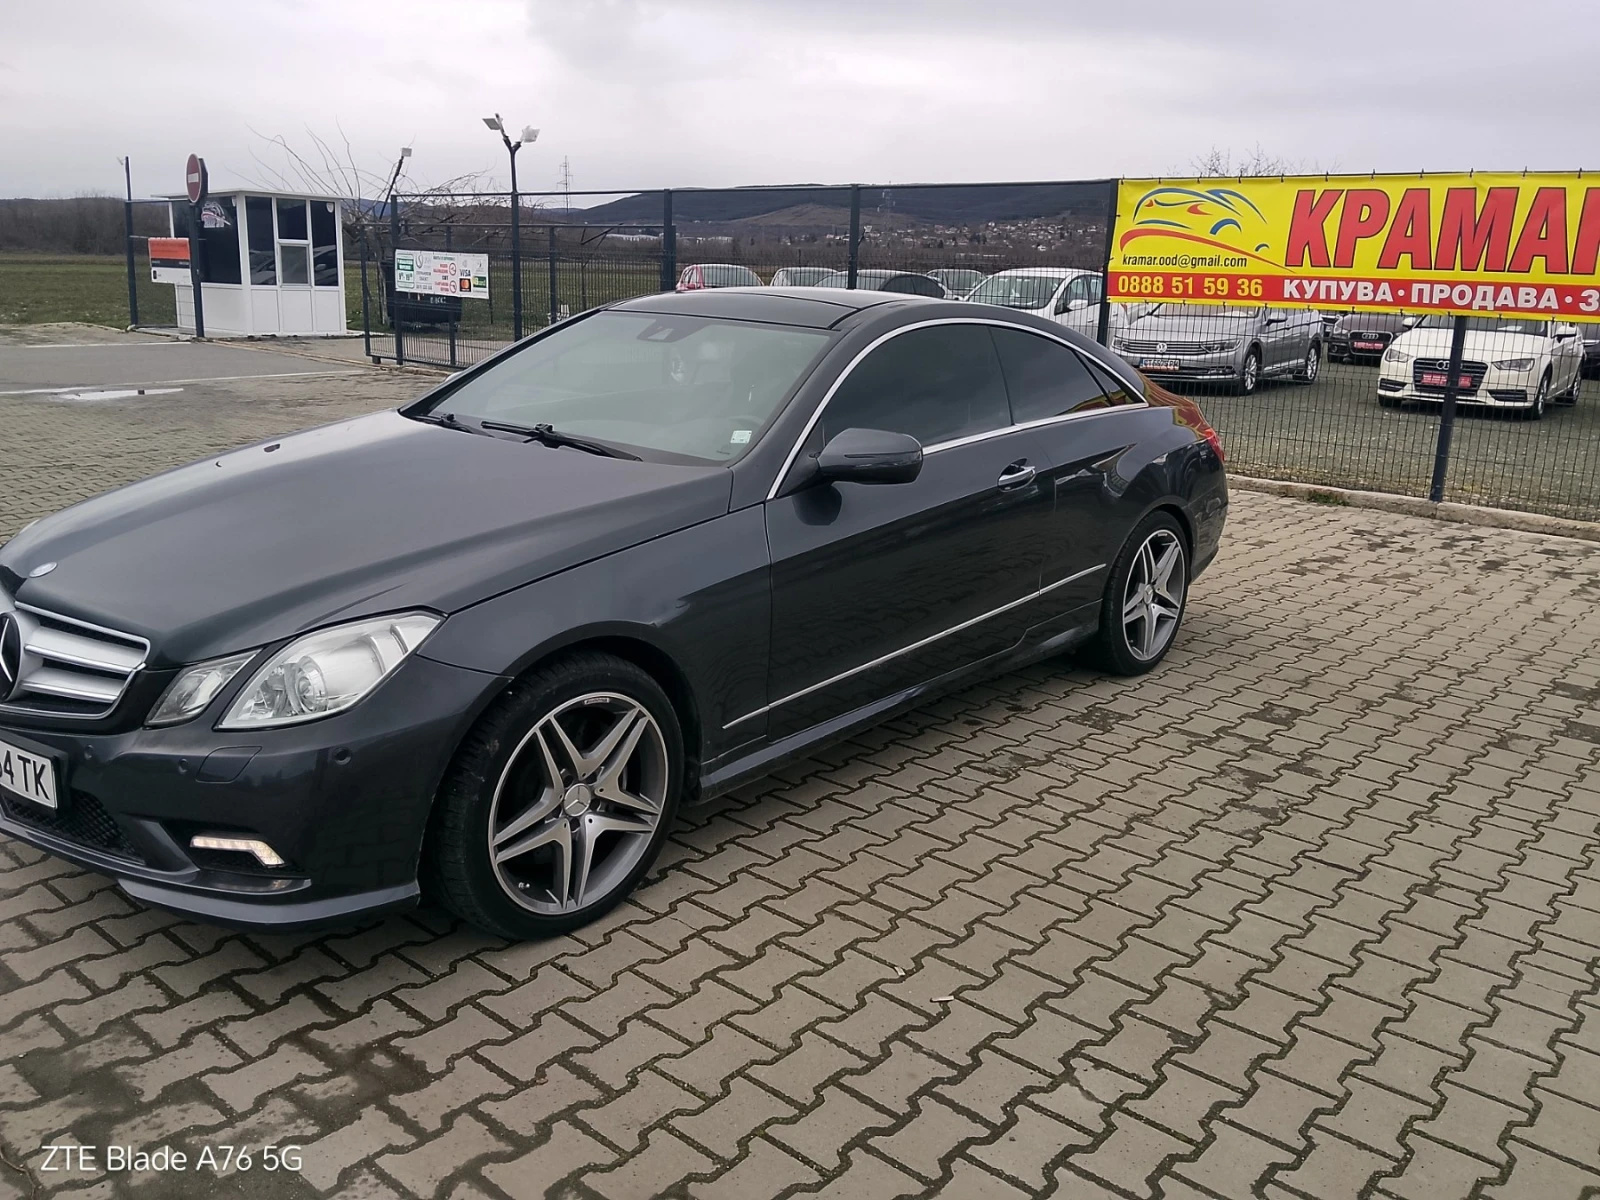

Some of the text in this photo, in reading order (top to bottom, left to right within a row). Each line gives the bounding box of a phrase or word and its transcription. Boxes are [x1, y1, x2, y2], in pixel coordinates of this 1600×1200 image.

[1122, 254, 1247, 269] kramar.ood@gmail.com
[1118, 275, 1263, 297] 0888 51 59 36
[1282, 279, 1600, 312] КУПУВА ПРОДАВА З
[0, 749, 50, 801] 4 TK
